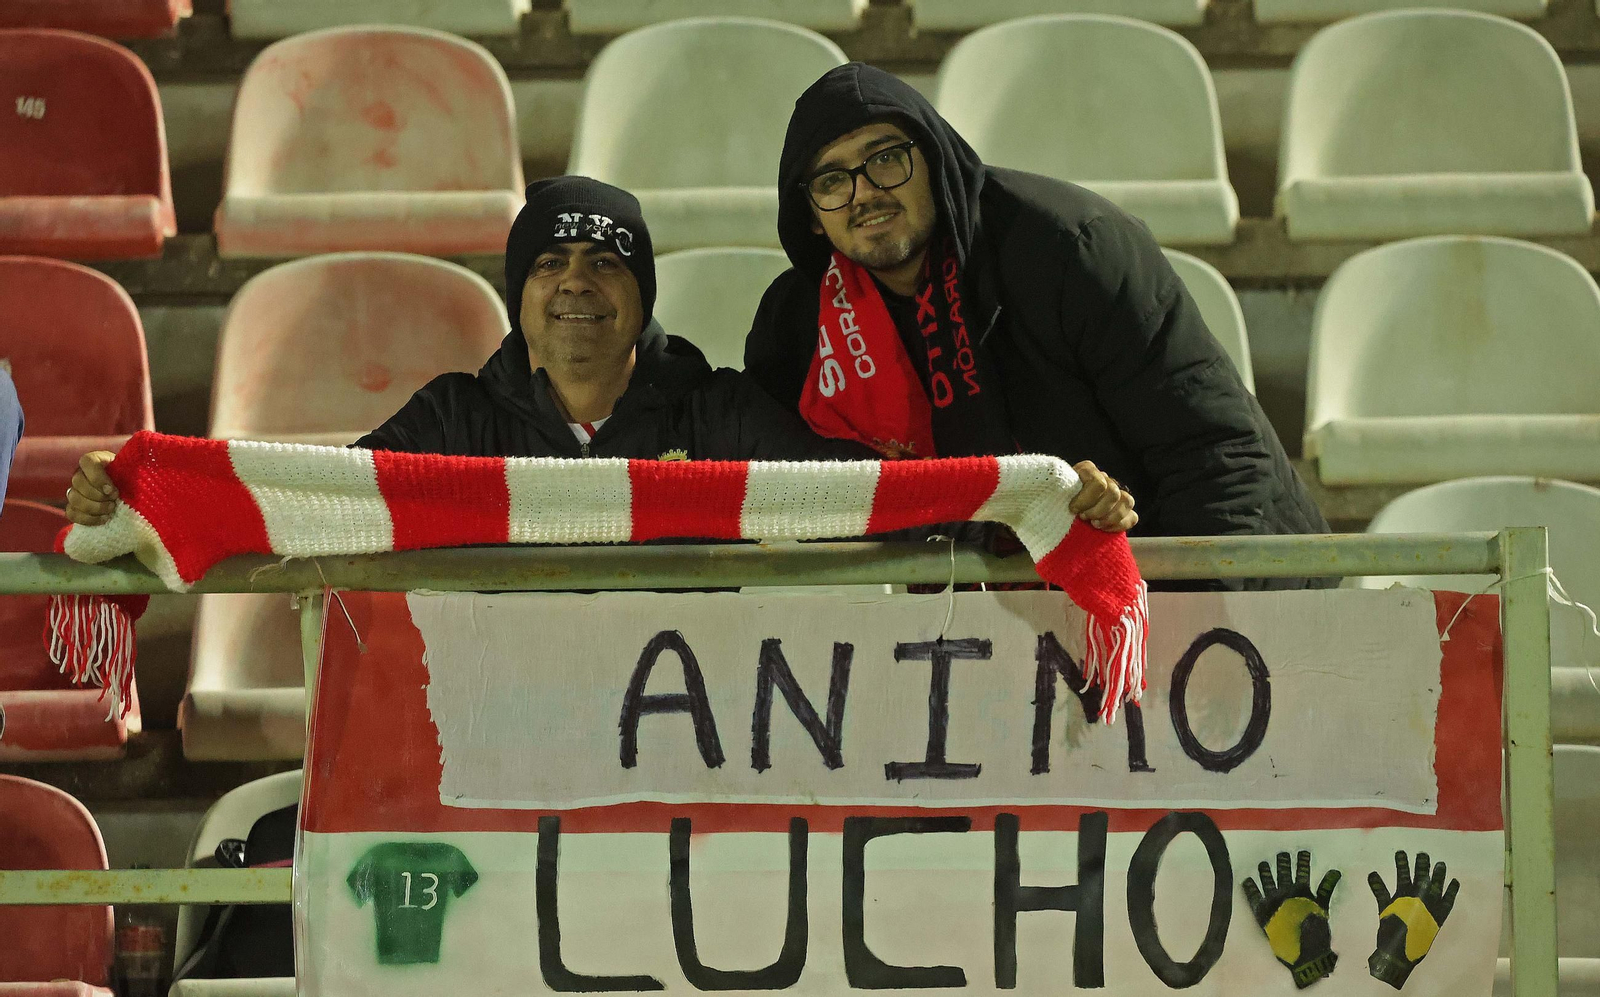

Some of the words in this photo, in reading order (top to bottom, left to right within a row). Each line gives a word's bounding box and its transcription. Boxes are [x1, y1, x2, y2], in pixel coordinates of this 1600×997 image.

[585, 223, 614, 237] york
[619, 627, 1271, 782] ANIMO
[398, 871, 439, 910] 13
[536, 811, 1233, 993] LUCHO
